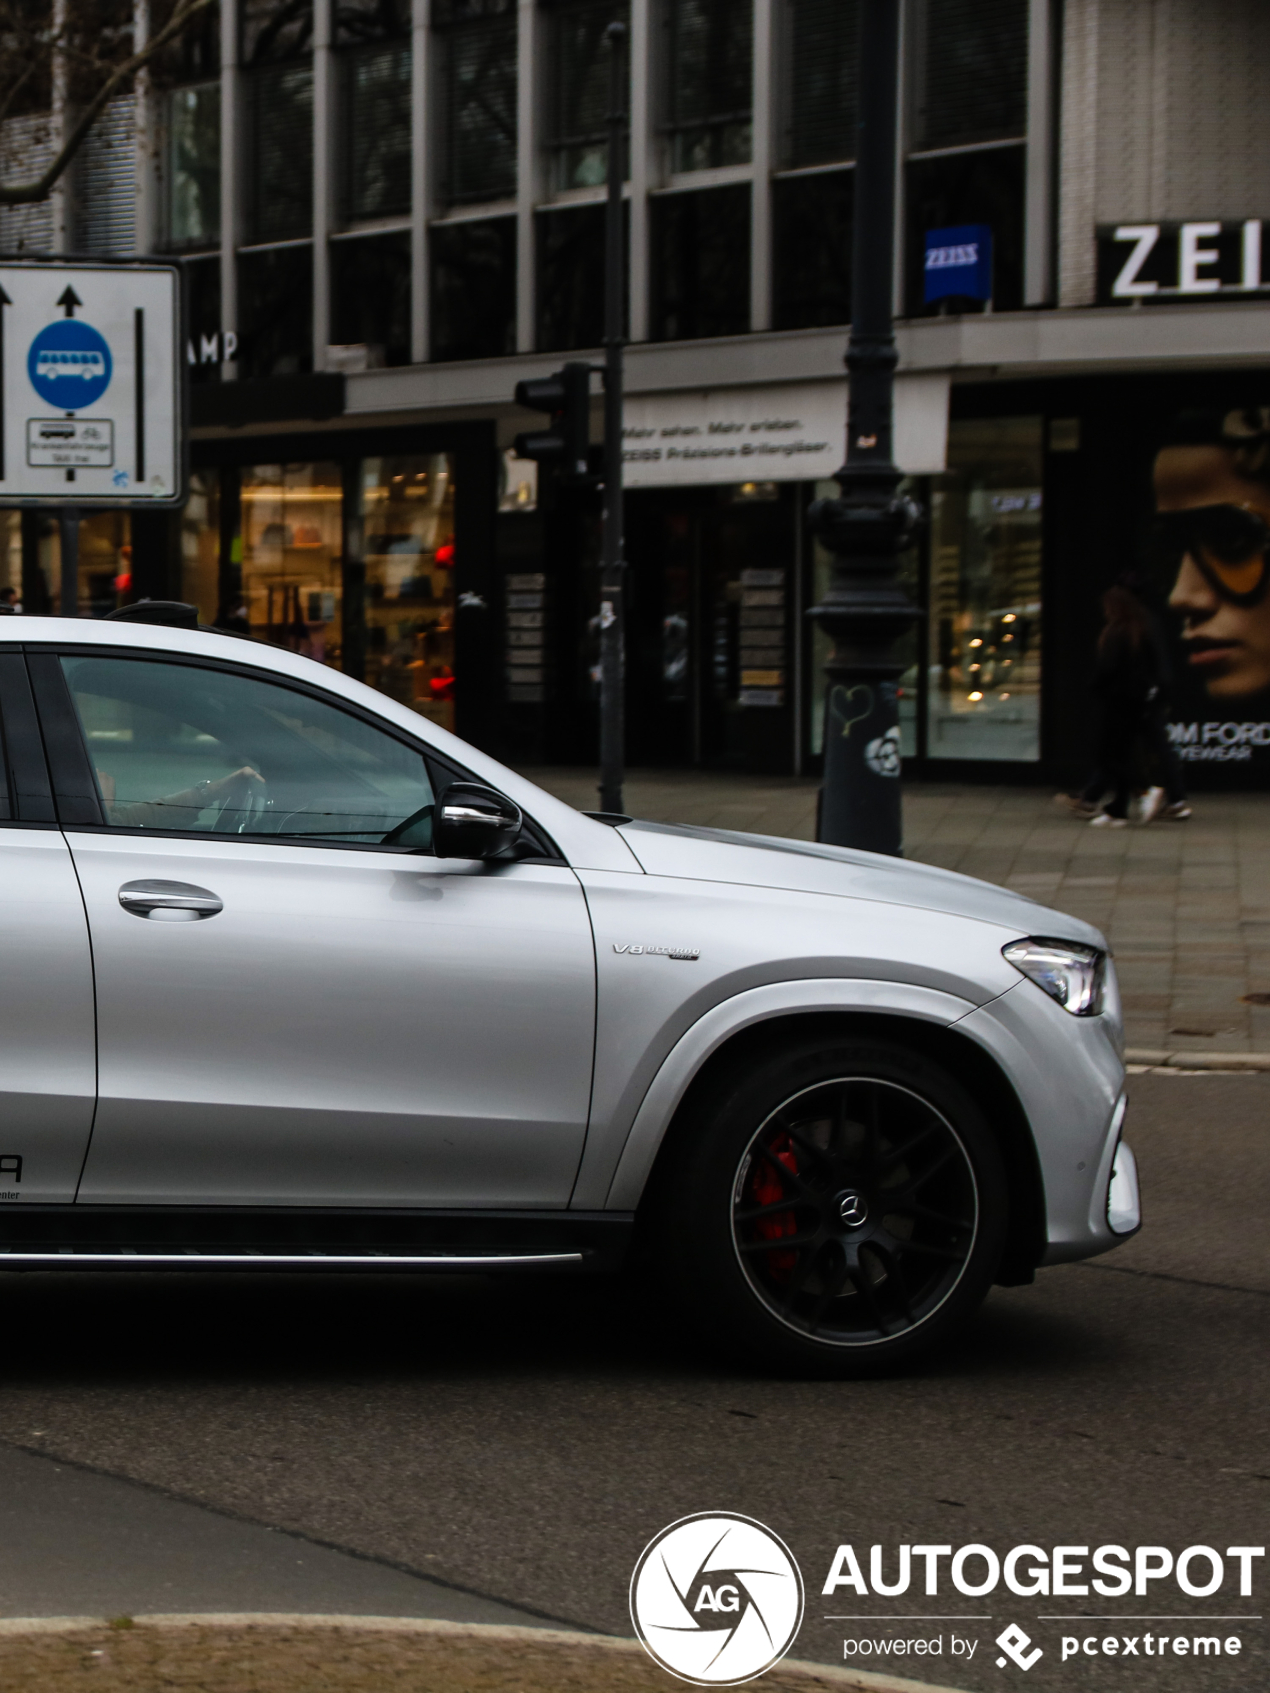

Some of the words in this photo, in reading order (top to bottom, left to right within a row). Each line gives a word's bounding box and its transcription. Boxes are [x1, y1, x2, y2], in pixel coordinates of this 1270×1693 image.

[926, 244, 979, 269] ZEISS
[1112, 219, 1262, 297] ZEI
[613, 943, 645, 955] V8
